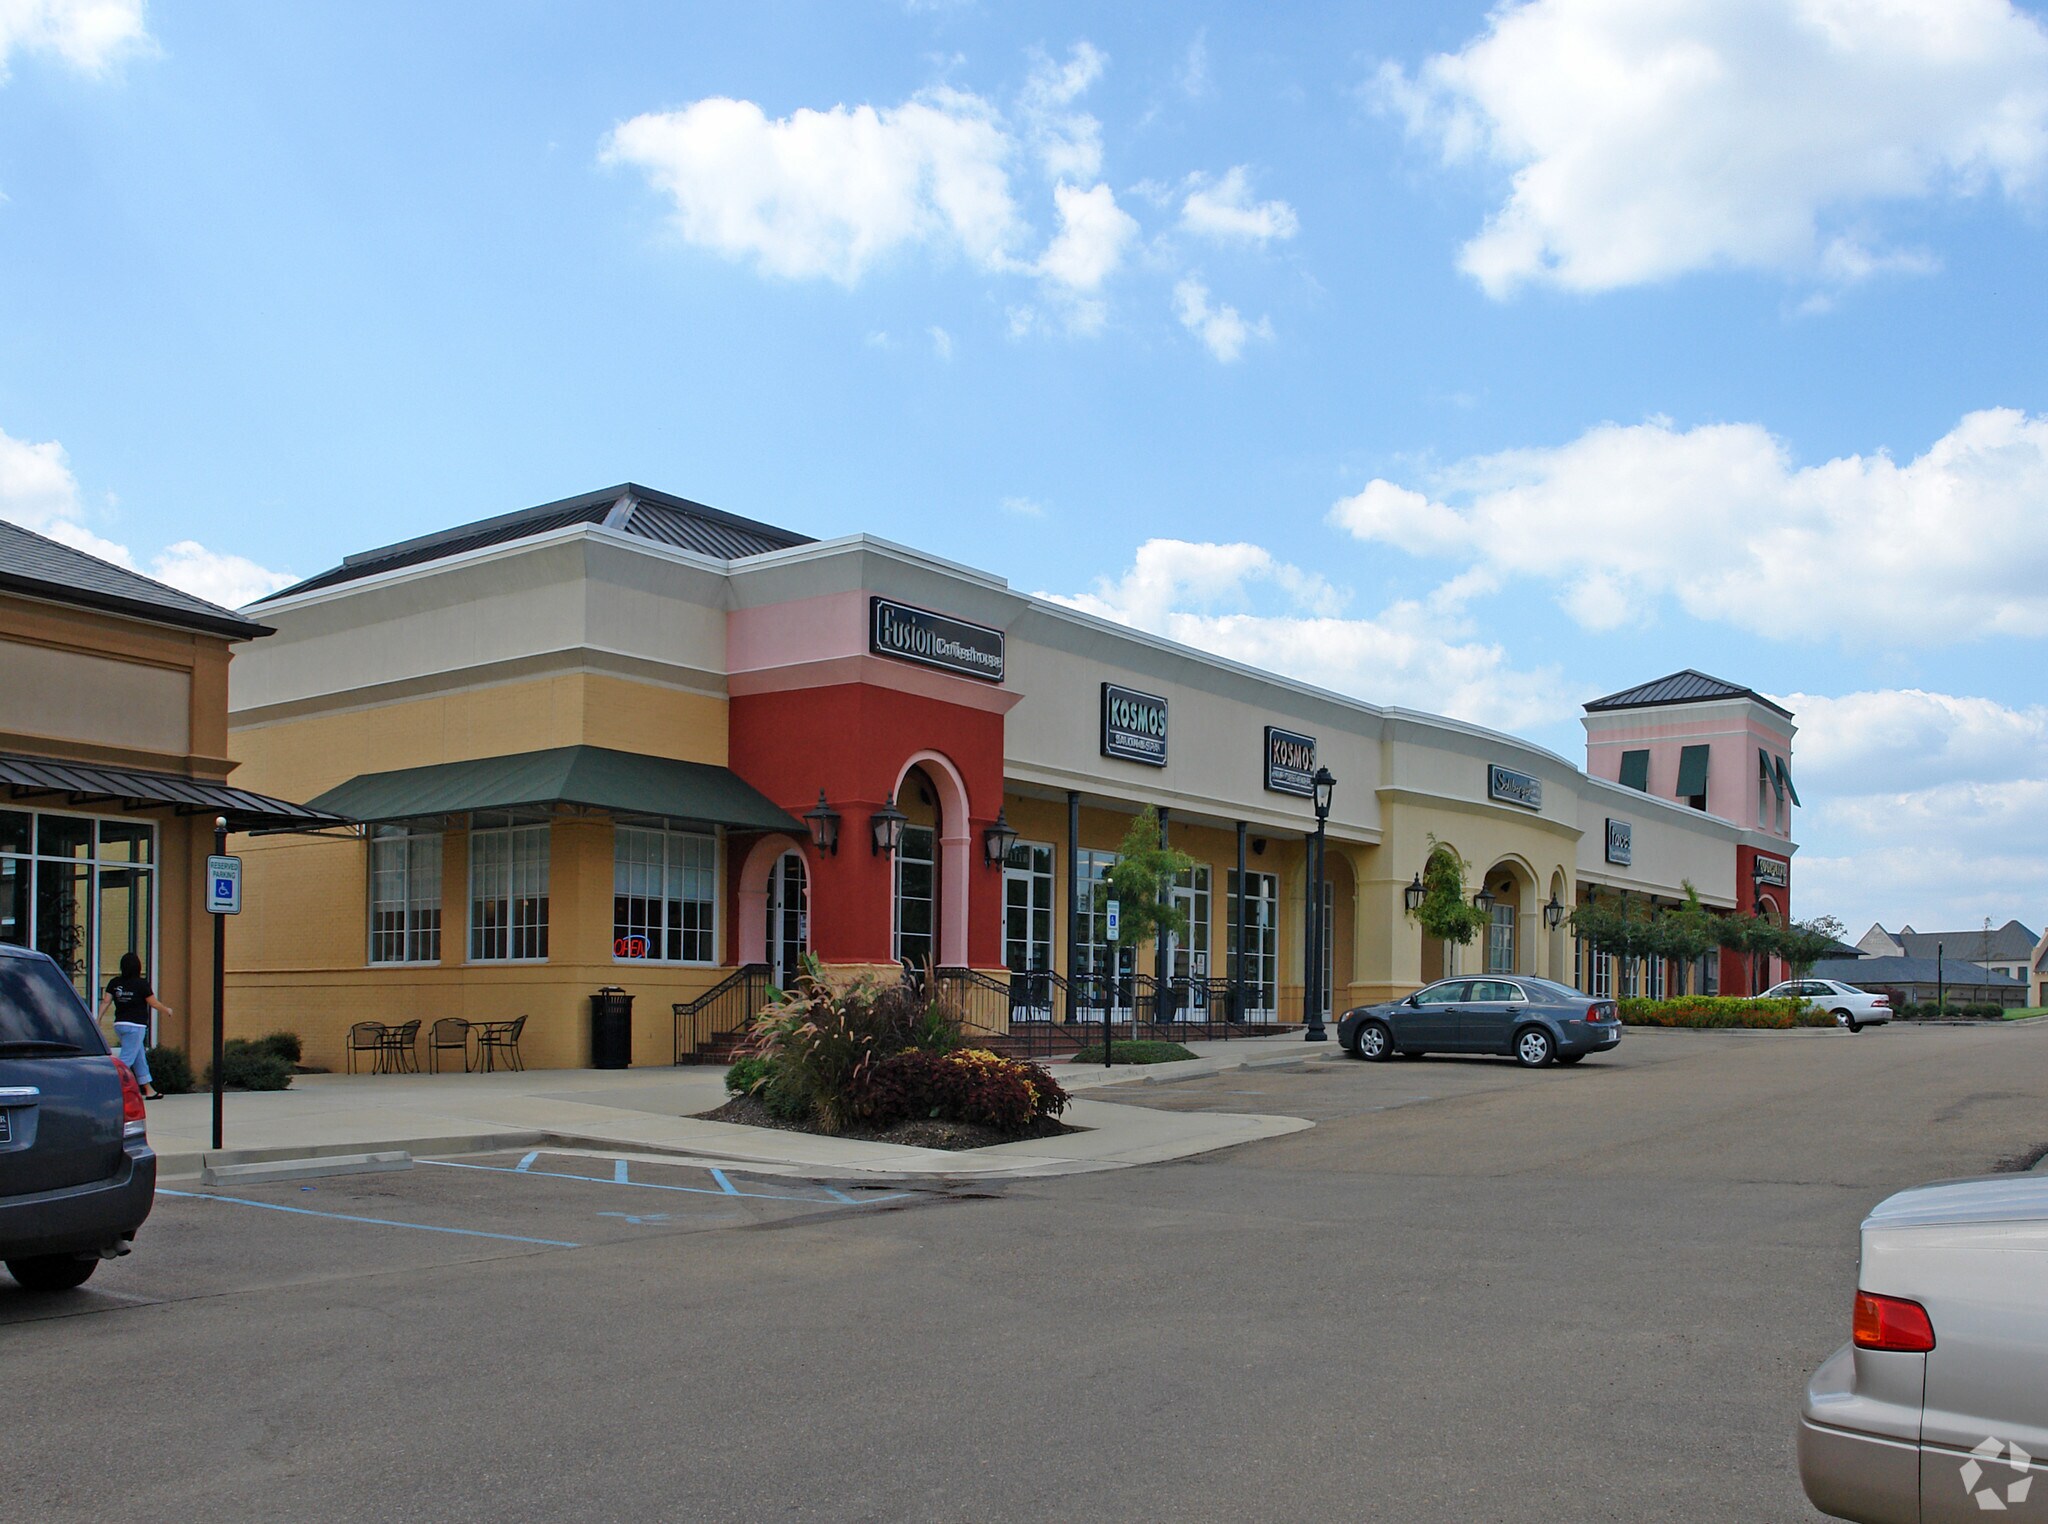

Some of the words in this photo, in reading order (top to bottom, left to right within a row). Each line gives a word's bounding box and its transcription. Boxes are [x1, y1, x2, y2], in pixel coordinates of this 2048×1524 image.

[883, 607, 937, 656] Fusion
[1111, 697, 1165, 737] KOSMOS
[1273, 738, 1315, 772] KOSMOS
[210, 861, 239, 871] RESERVED
[212, 870, 236, 879] PARKING
[613, 938, 646, 957] OPEN
